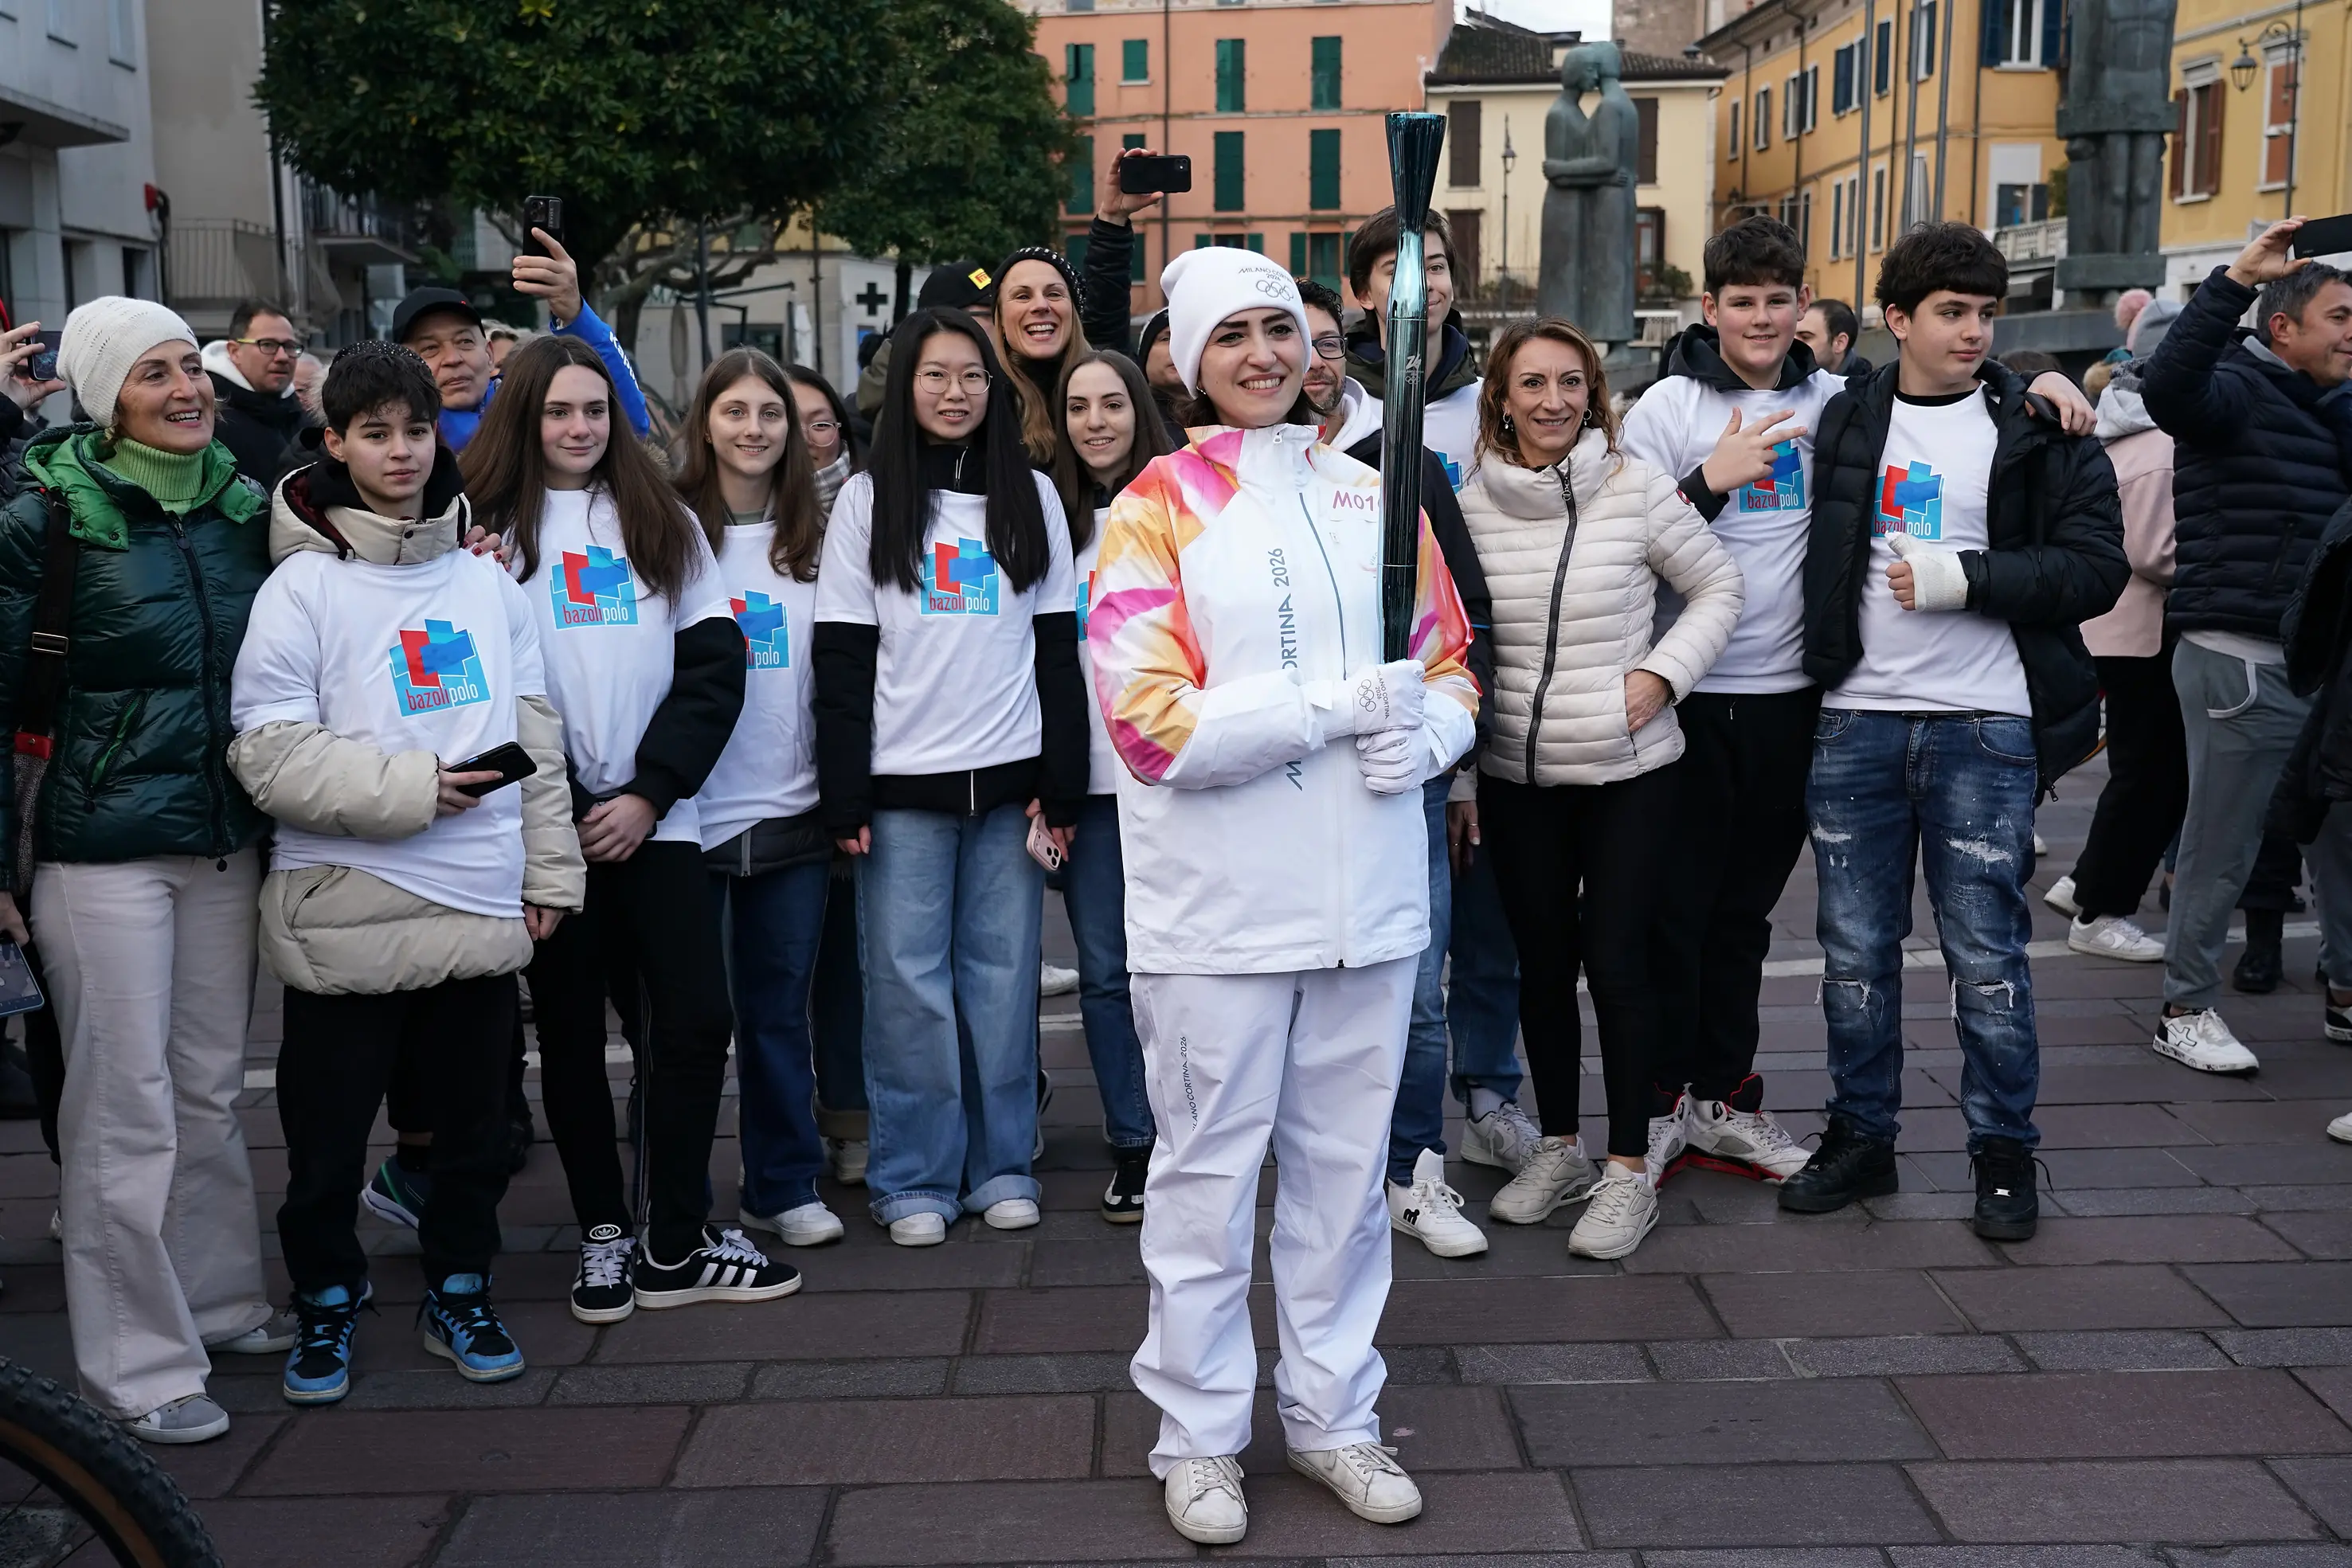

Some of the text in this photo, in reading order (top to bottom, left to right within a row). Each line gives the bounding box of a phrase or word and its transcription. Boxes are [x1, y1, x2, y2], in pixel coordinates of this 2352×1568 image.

[1333, 490, 1380, 511] M01
[562, 600, 628, 625] bazolipolo
[929, 591, 990, 614] bazolipolo
[1268, 548, 1298, 669] ORTINA 2026
[405, 678, 479, 711] bazolipolo
[1182, 1061, 1195, 1101] CORTINA
[1189, 1101, 1198, 1132] ILANO
